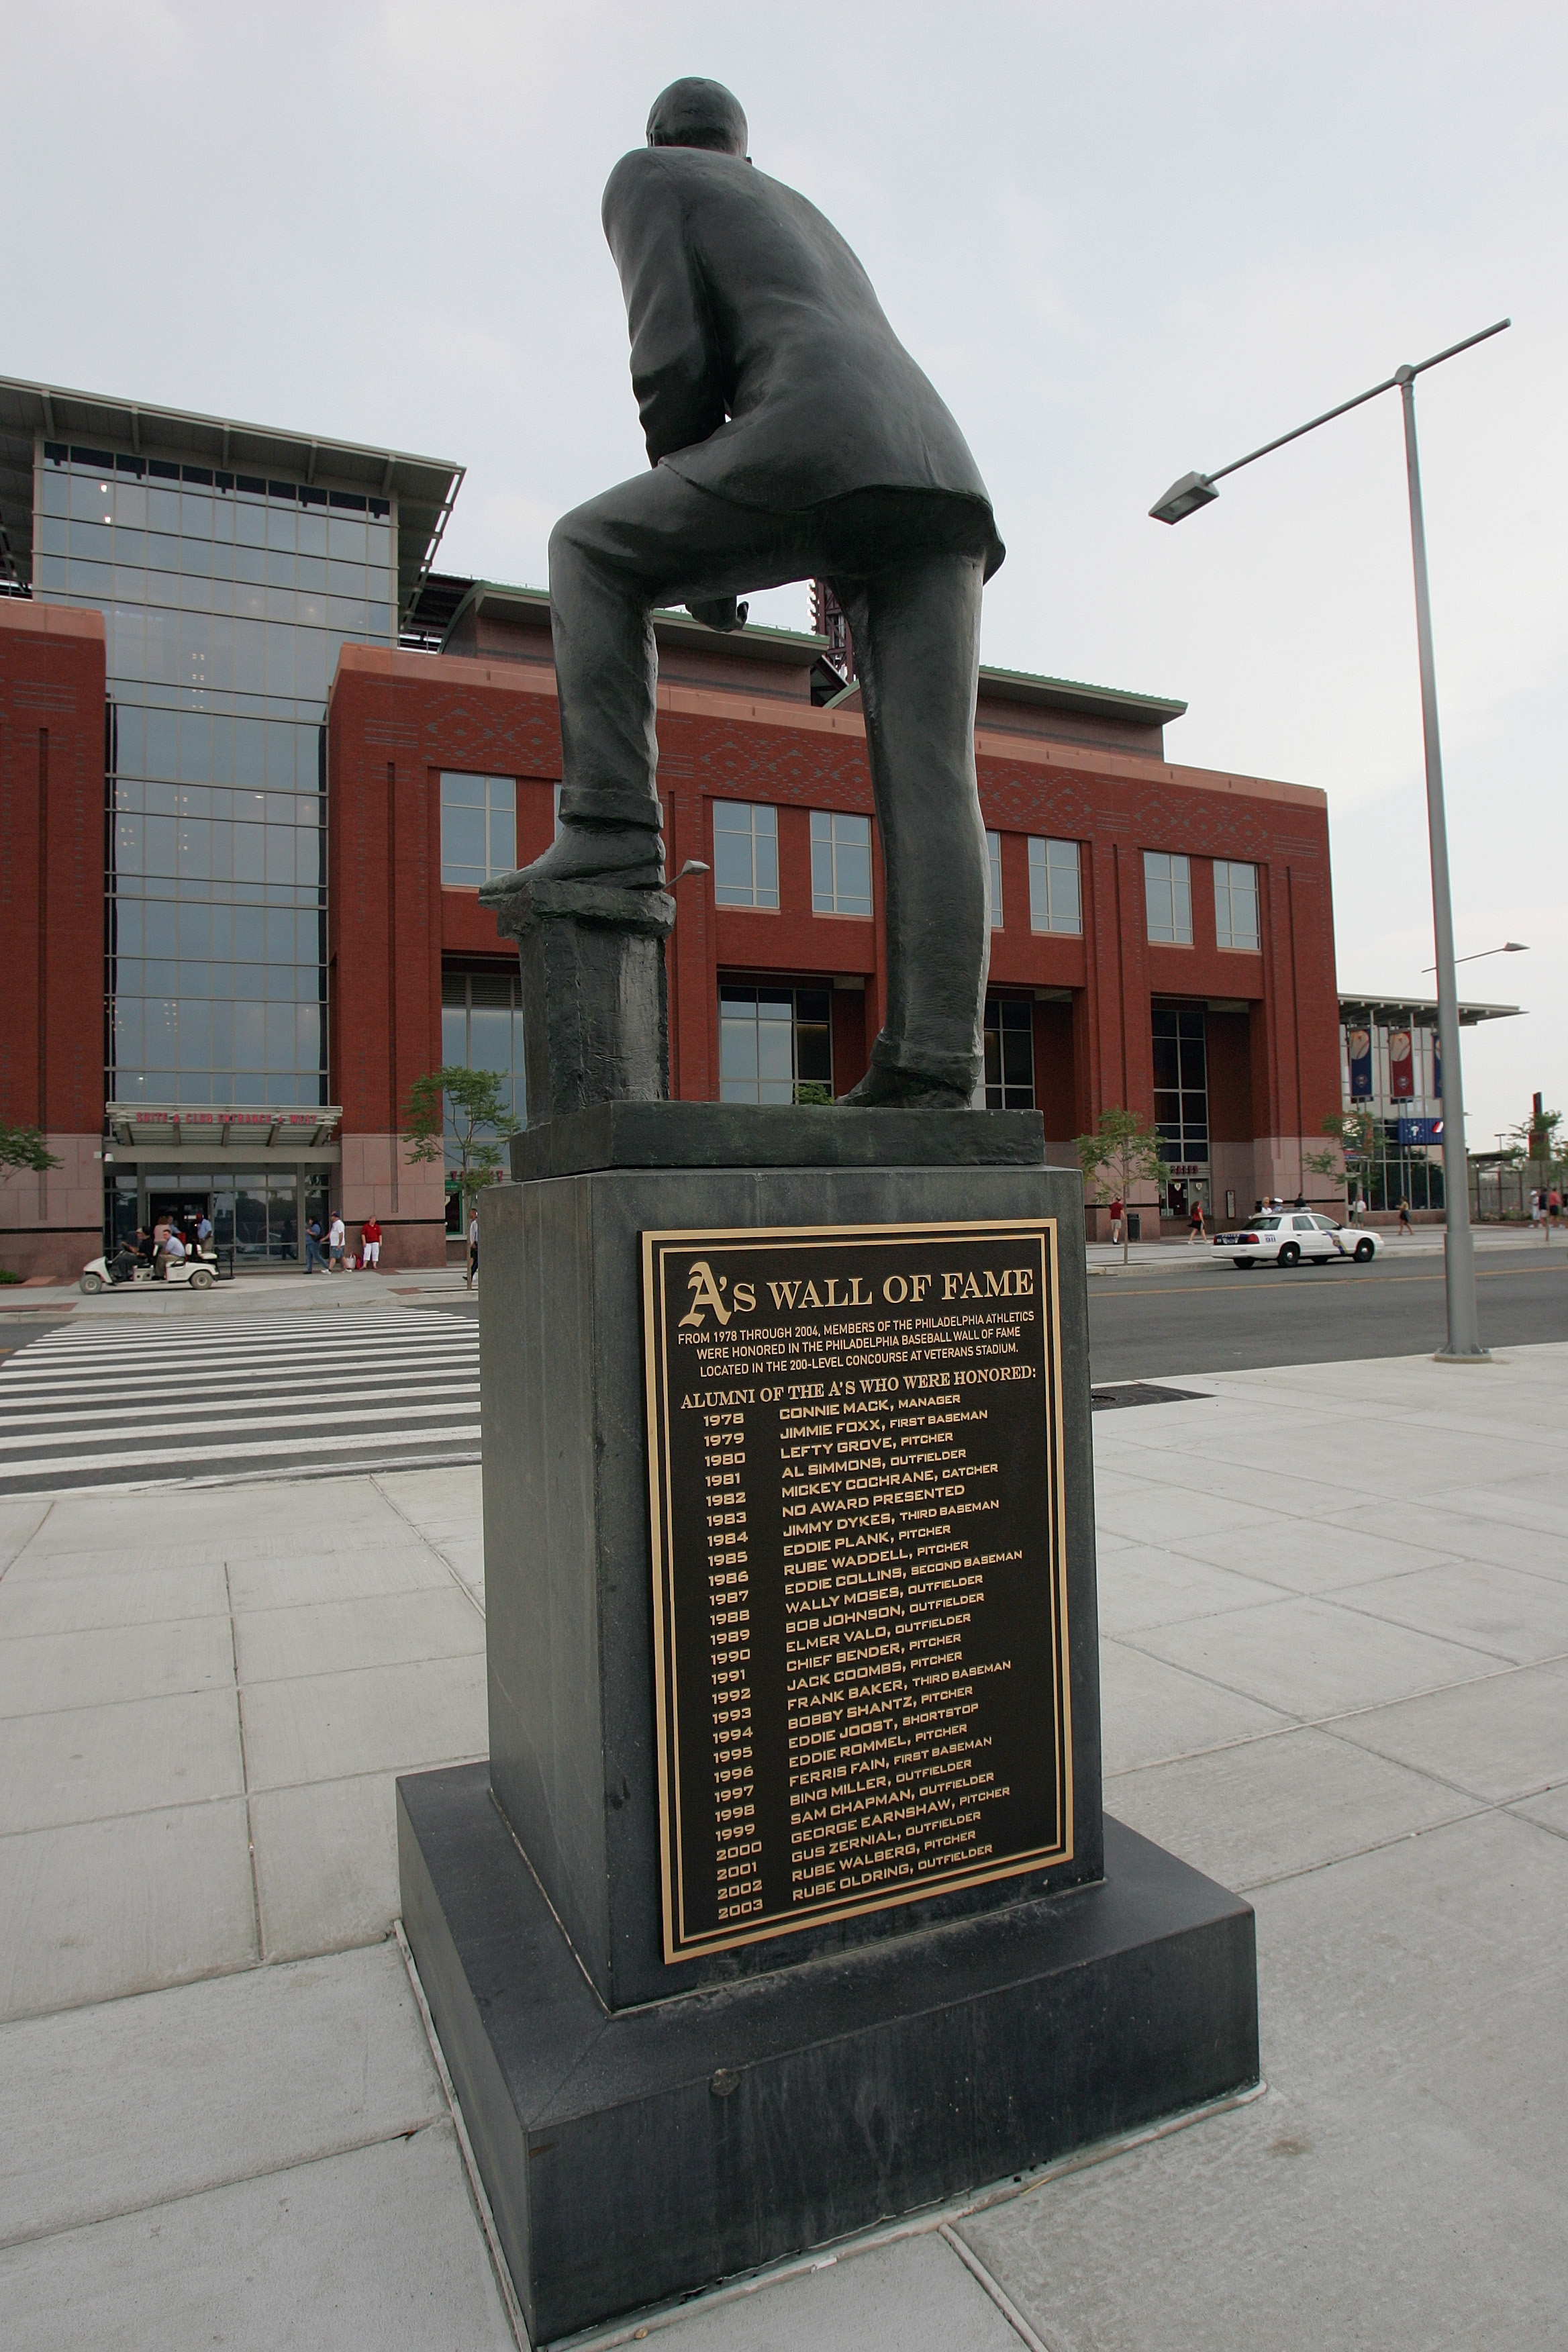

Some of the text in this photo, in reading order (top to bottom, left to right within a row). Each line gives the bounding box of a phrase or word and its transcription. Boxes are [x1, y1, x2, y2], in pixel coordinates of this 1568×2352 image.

[136, 1112, 168, 1123] SUITE
[185, 1113, 213, 1124] CLUB
[217, 1114, 271, 1124] ENTRANCE
[290, 1114, 316, 1124] WEST
[766, 1277, 873, 1310] WALL
[883, 1274, 932, 1304] OF
[940, 1269, 1034, 1300] FAME
[678, 1310, 1034, 1344] FROM 1978 THROUGH 2004, MEMBERS OF THE PHILADELPHIA ATHLETICS
[696, 1326, 1021, 1360] WERE HONORED IN THE PHILADELPHIA BASEBALL WALL OF FAME
[700, 1342, 1018, 1377] LOCATED IN THE 200-LEVEL CONCOURSE AT VETERANS STADIUM.
[681, 1365, 1036, 1409] ALUMNI OF THE A'S WHO WERE HONORED:
[703, 1394, 961, 1427] 1978 CONNIE MACK, MANAGER
[703, 1410, 988, 1447] 1979 JIMMIE FOXX, FIRST BASEMAN
[704, 1432, 954, 1467] 1980 LEFTY GROVE, PITCHER
[705, 1449, 967, 1487] 1981 AL SIMMONS, OUTFIELDER
[705, 1463, 998, 1507] 1982 MICKEY COCHRANE, CATCHER
[706, 1484, 965, 1527] 1983 NO AWARD PRESENTED
[707, 1500, 999, 1547] 1984 JIMMY DYKES, THIRD BASEMAN
[707, 1524, 951, 1567] 1985 EDDIE PLANK, PITCHER
[708, 1540, 969, 1587] 1986 RUBE WADDELL, PITCHER
[709, 1550, 1022, 1606] 1987 EDDIE COLLINS, SECOND BASEMAN
[709, 1574, 983, 1626] 1988 WALLY MOSES, OUTFIELDER
[710, 1592, 985, 1645] 1989 BOB JOHNSON, OUTFIELDER
[711, 1613, 971, 1665] 1990 ELMER VALO, OUTFIELDER
[711, 1633, 961, 1685] 1991 CHIEF BENDER, PITCHER
[712, 1651, 963, 1705] 1992 JACK COOMBS, PITCHER
[712, 1660, 1011, 1724] 1993 FRANK BAKER, THIRD BASEMAN
[713, 1685, 973, 1744] 1994 BOBBY SHANTZ, PITCHER
[713, 1703, 979, 1763] 1995 EDDIE JOOST, SHORTSTOP
[714, 1723, 967, 1783] 1996 EDDIE ROMMEL, PITCHER
[714, 1736, 992, 1803] 1997 FERRIS FAIN, FIRST BASEMAN
[715, 1759, 972, 1822] 1998 BING MILLER, OUTFIELDER
[716, 1772, 994, 1842] 1999 SAM CHAPMAN, OUTFIELDER
[716, 1787, 1010, 1861] 2000 GEORGE EARNSHAW, PITCHER
[717, 1811, 981, 1881] 2001 GUS ZERNIAL, OUTFIELDER
[717, 1830, 976, 1900] 2002 RUBE WALBERG, PITCHER
[718, 1844, 993, 1920] 2003 RUBE OLDRING, OUTFIELDER
